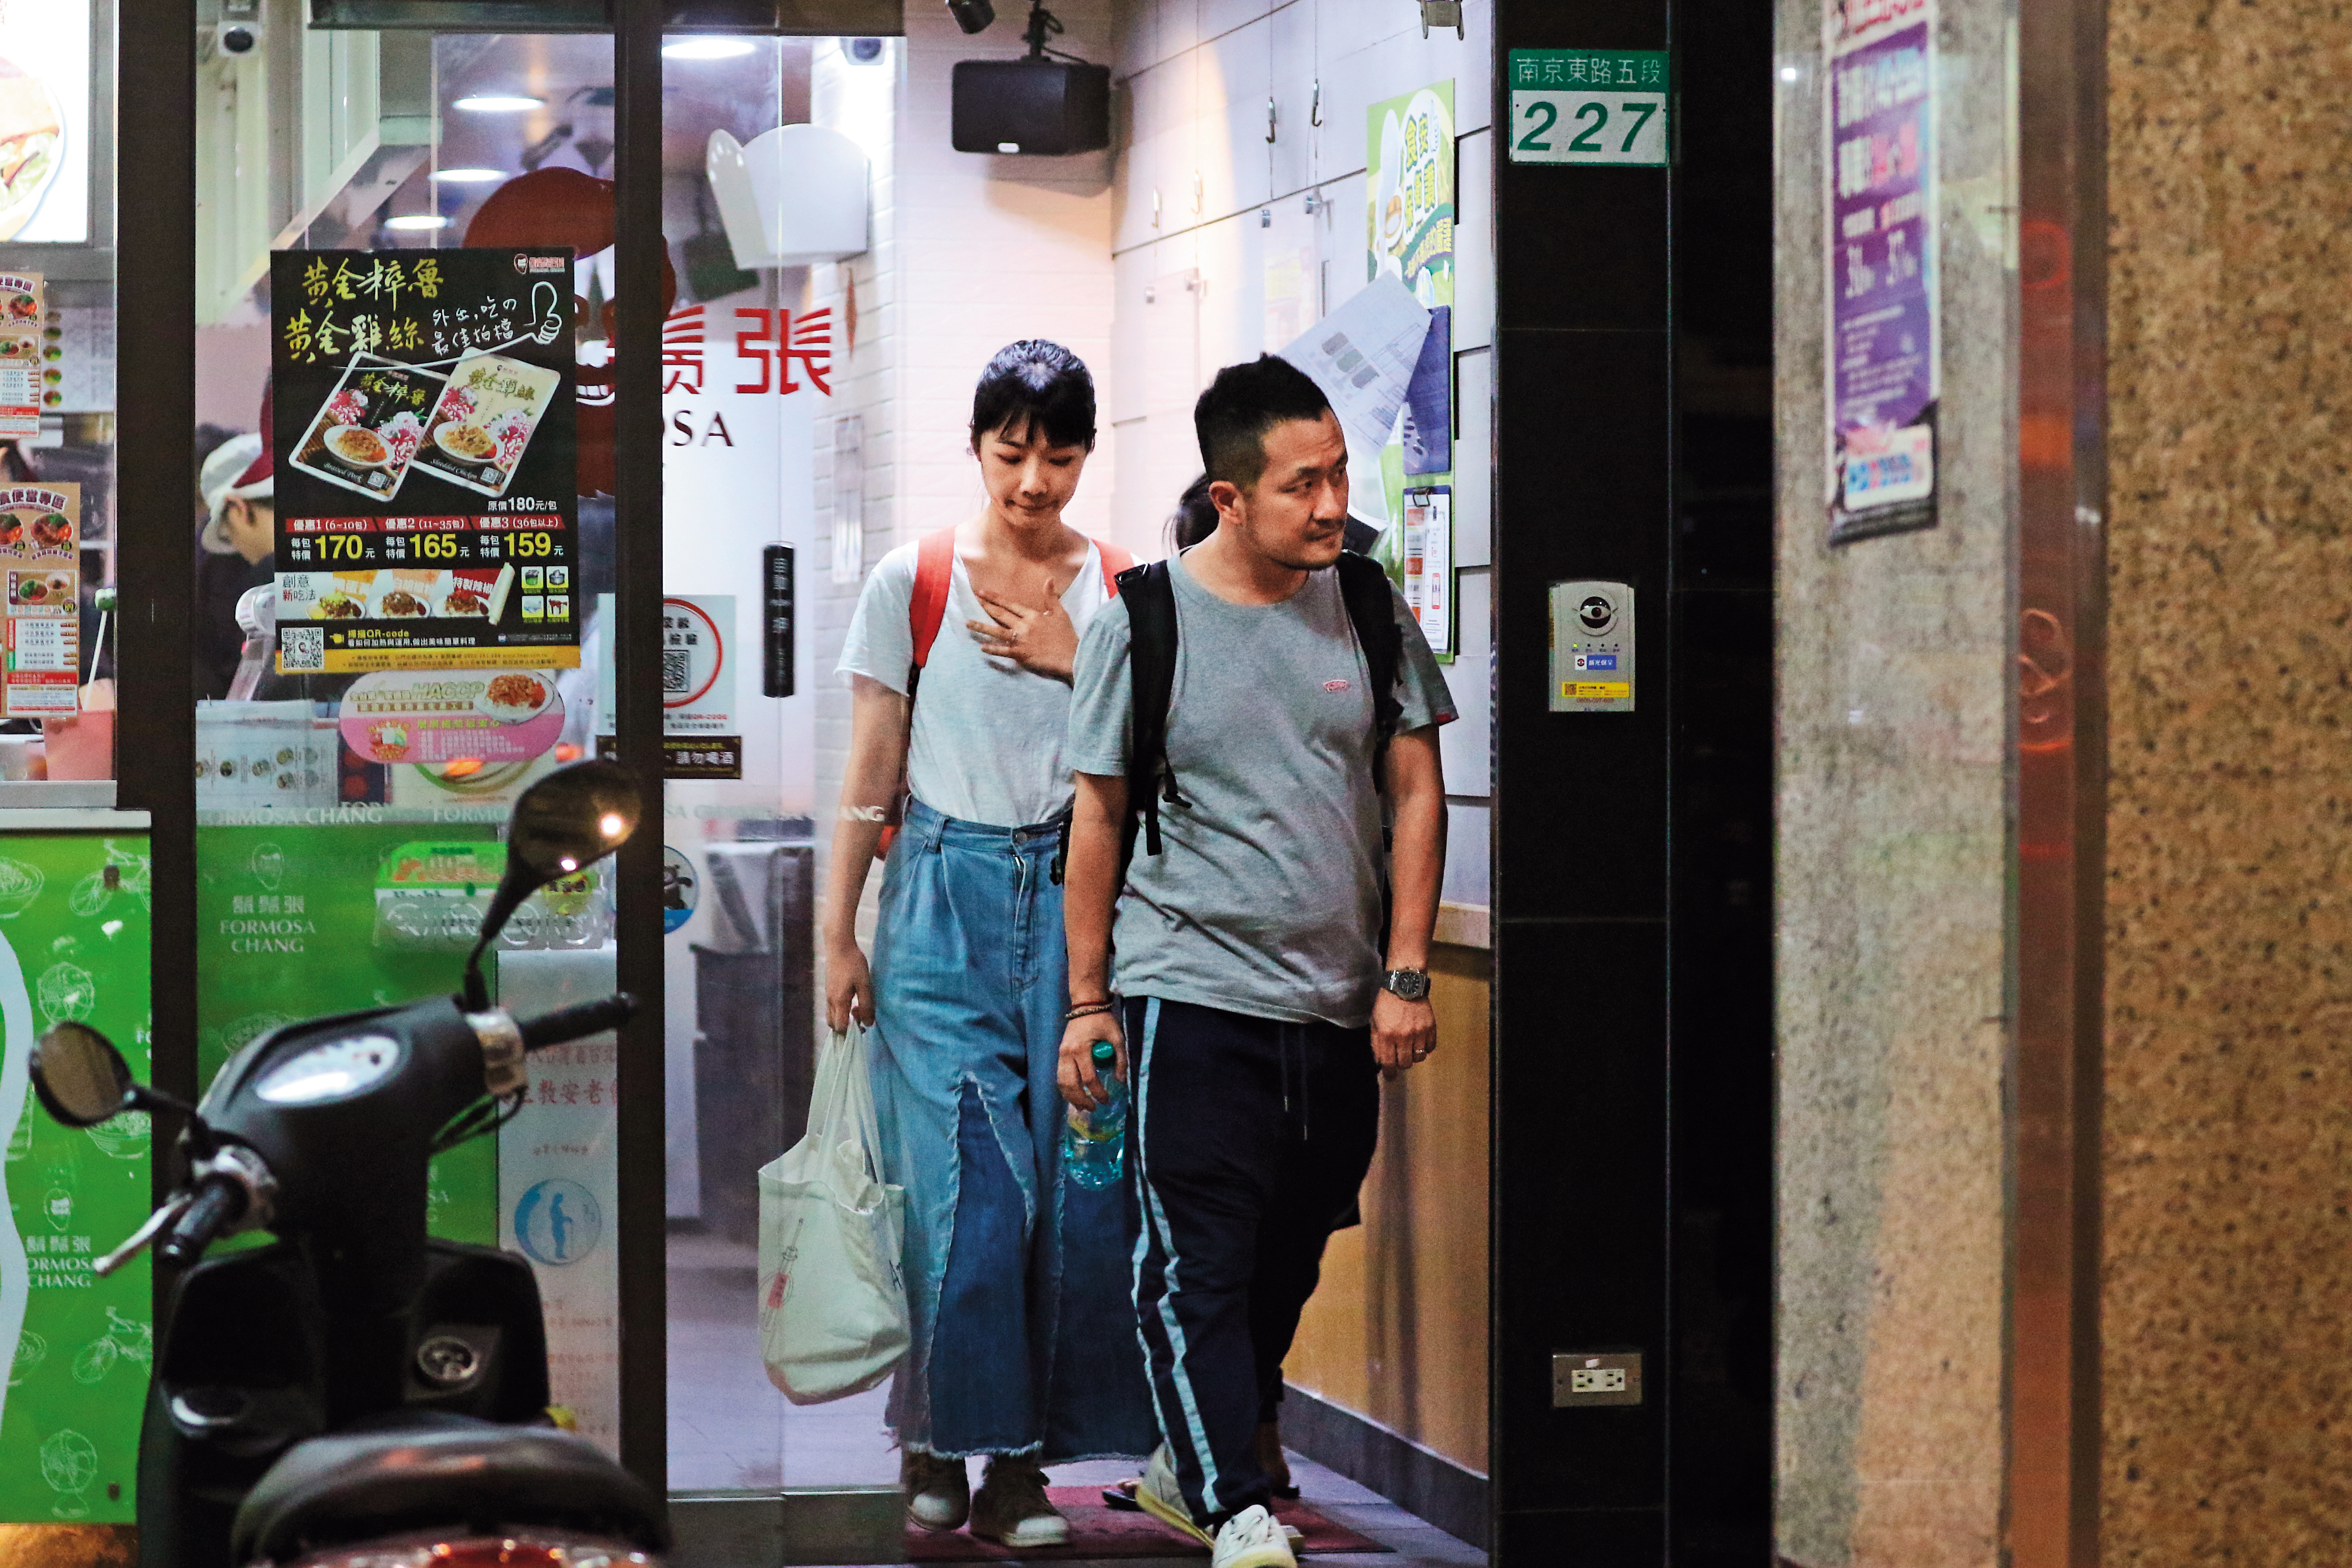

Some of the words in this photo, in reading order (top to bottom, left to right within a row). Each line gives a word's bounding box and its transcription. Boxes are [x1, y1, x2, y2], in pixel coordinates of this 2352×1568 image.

[1517, 57, 1661, 84] 南京東路五段
[1517, 101, 1657, 152] 227
[284, 308, 424, 364] 黃金雞絲
[432, 318, 514, 357] 最佳拍檔
[662, 410, 735, 447] SA
[488, 496, 557, 511] 原價180元/包
[293, 519, 321, 530] 優惠1
[385, 518, 415, 529] 優惠2
[479, 517, 509, 528] 優惠3
[291, 537, 311, 548] 每包
[315, 534, 363, 559] 170
[365, 548, 375, 559] 元
[386, 536, 405, 547] 每包
[409, 533, 457, 558] 165
[459, 546, 470, 557] 元
[480, 535, 499, 545] 每包
[503, 532, 551, 557] 159
[554, 545, 564, 556] 元
[291, 549, 311, 560] 特價
[386, 548, 405, 559] 特價
[480, 547, 499, 558] 特價
[282, 574, 310, 588] 創意
[282, 588, 316, 602] 新吃法
[412, 681, 485, 700] HACCP
[305, 806, 383, 824] CHANG
[433, 806, 513, 824] FORMO
[220, 919, 316, 935] FORMOSA
[231, 938, 304, 953] CHANG
[27, 1257, 94, 1271] ORMOS
